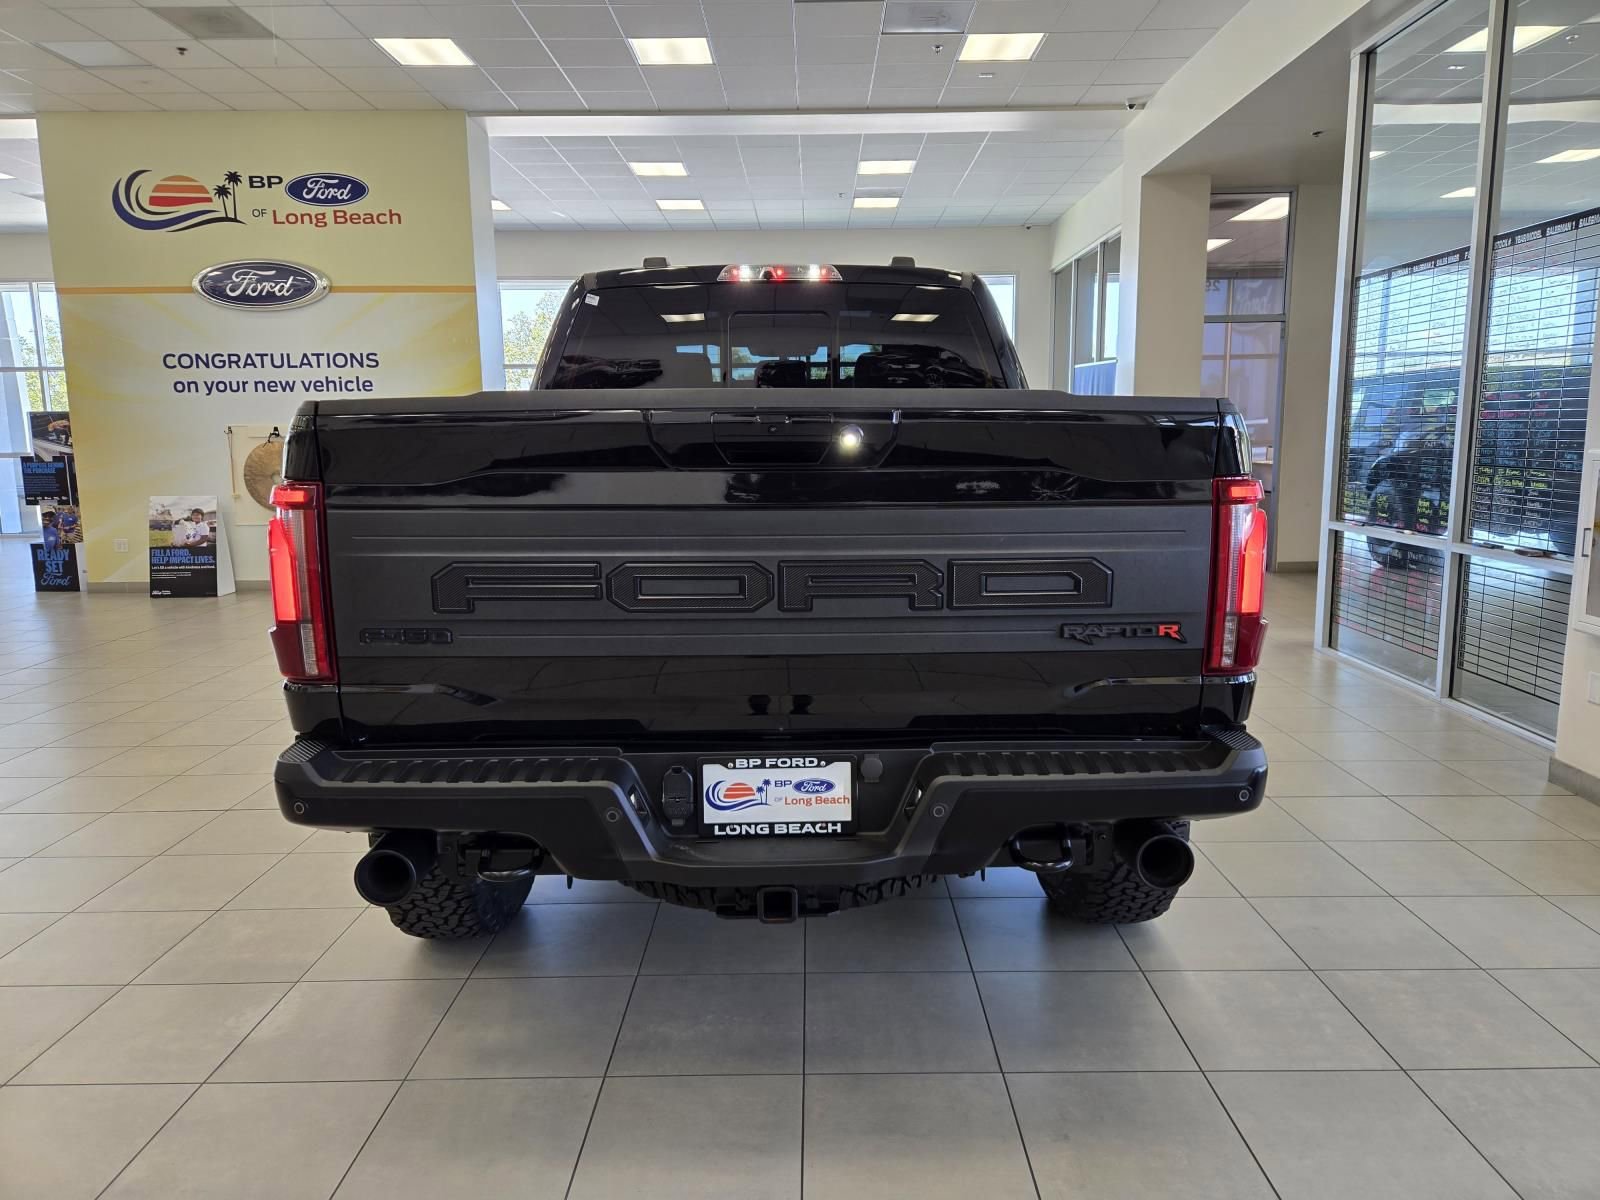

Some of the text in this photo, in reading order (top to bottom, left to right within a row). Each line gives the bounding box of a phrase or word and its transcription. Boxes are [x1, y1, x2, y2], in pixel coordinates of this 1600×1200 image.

[248, 175, 351, 201] BP Ford
[251, 208, 402, 228] OF Long Beach
[225, 268, 295, 297] Ford
[162, 352, 380, 370] CONGRATULATIONS
[173, 376, 374, 396] on your new vehicle
[37, 549, 69, 561] READY
[152, 548, 192, 557] FILL A FORD.
[152, 555, 216, 564] HELP IMPACT LIVES.
[45, 561, 64, 573] SET
[41, 573, 72, 586] Ford
[431, 557, 1114, 614] FORD
[1062, 622, 1187, 645] RAPTOR
[735, 757, 818, 769] BP FORD
[774, 779, 827, 793] BP Ford
[784, 796, 812, 807] Long
[815, 795, 850, 805] Beach
[714, 822, 842, 836] LONG BEACH
